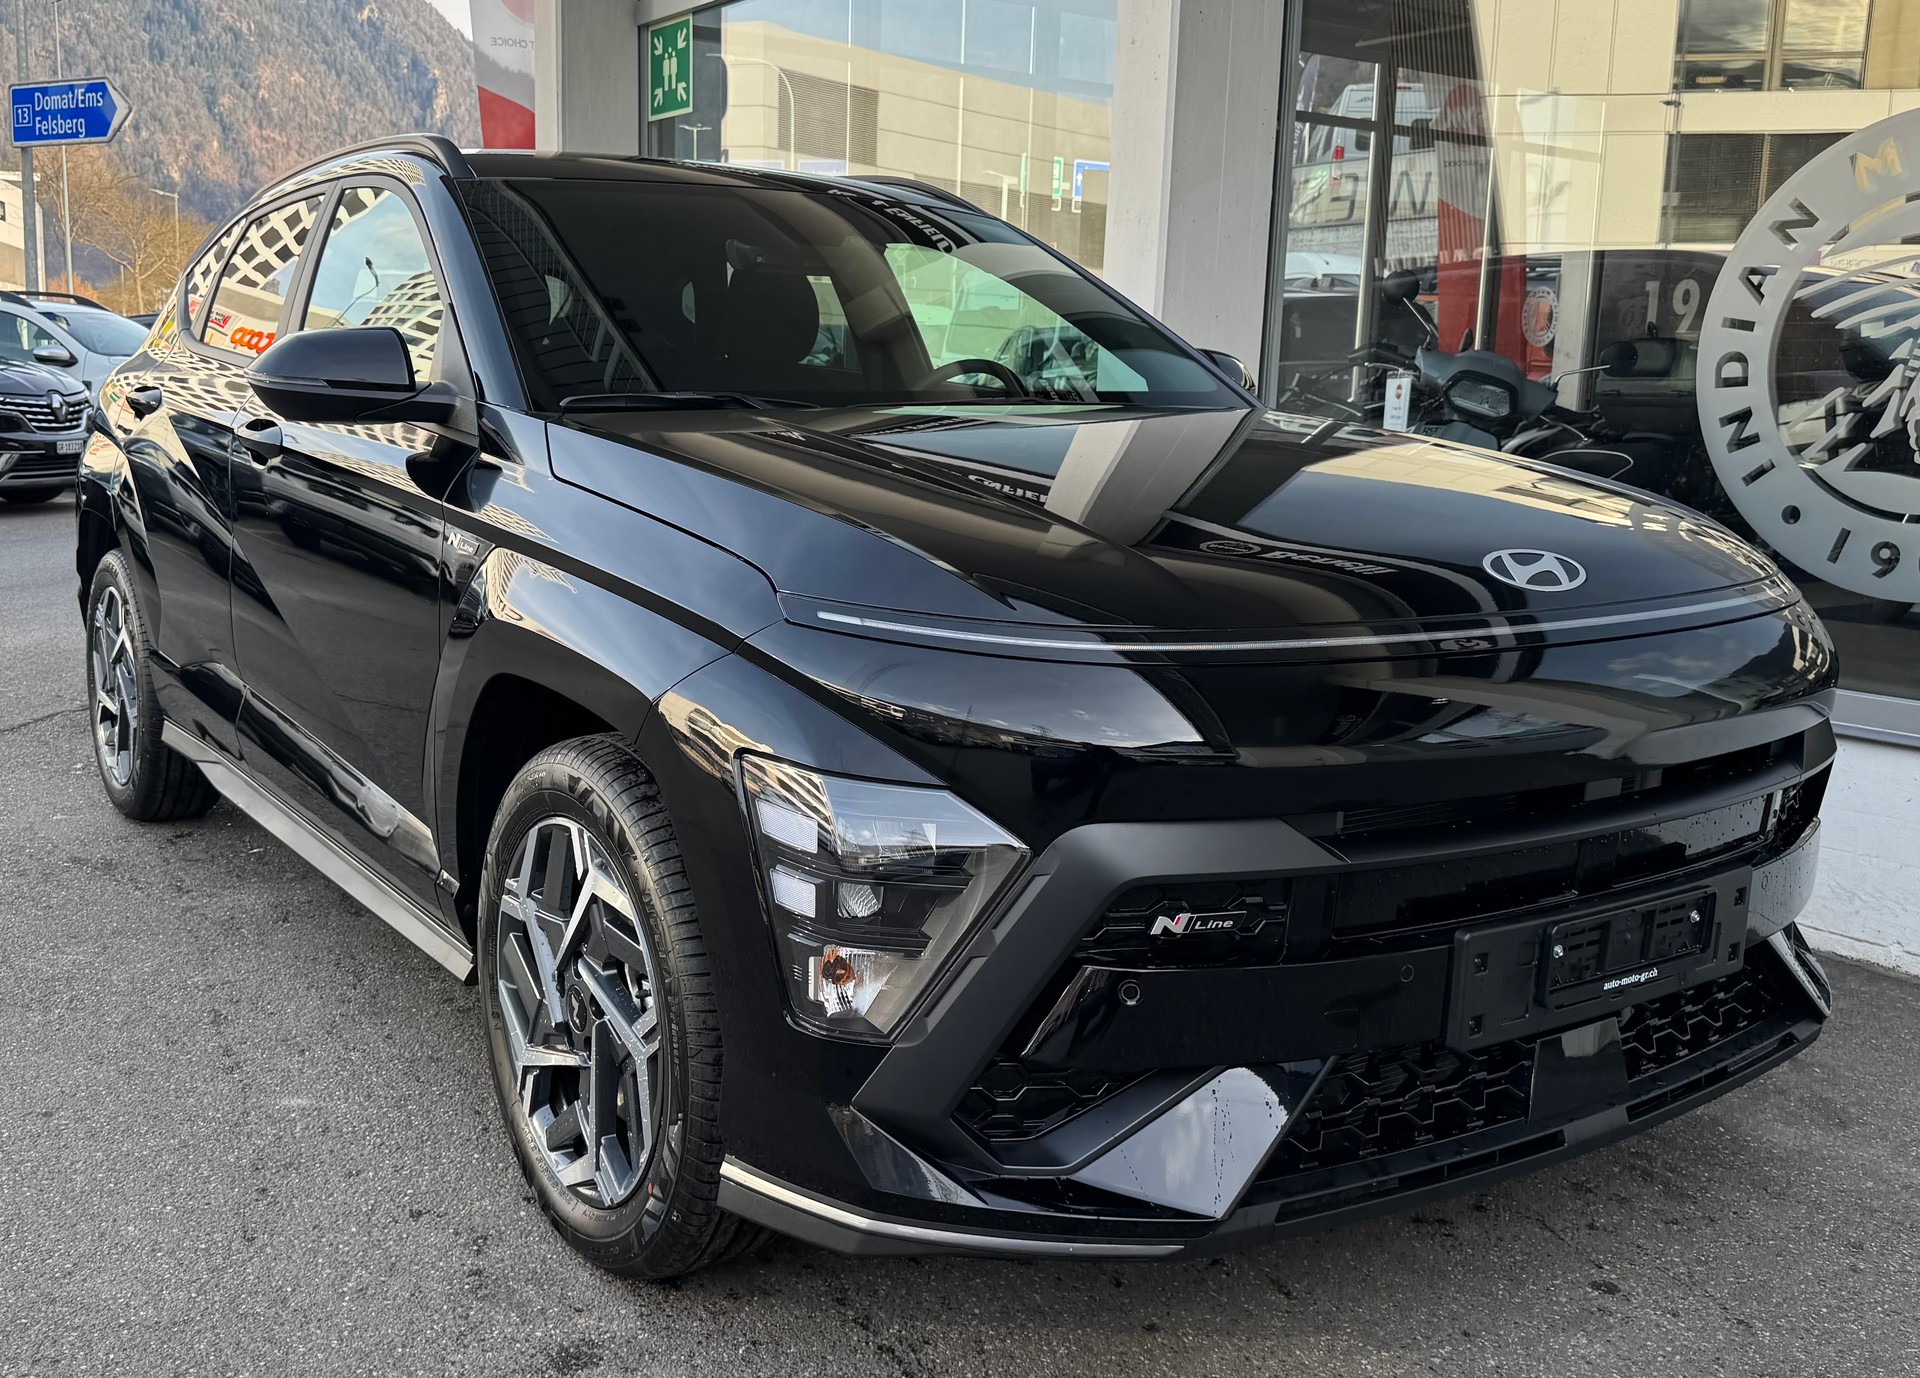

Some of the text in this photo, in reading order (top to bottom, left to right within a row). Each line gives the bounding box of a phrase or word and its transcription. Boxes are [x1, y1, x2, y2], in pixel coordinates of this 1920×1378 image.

[34, 88, 104, 111] Domat/Ems
[17, 107, 29, 124] 13
[35, 114, 86, 138] Felsberg
[1714, 196, 1821, 487] INDIAN
[1150, 912, 1234, 935] N Line
[1603, 967, 1659, 991] auto-moto-gr.ch
